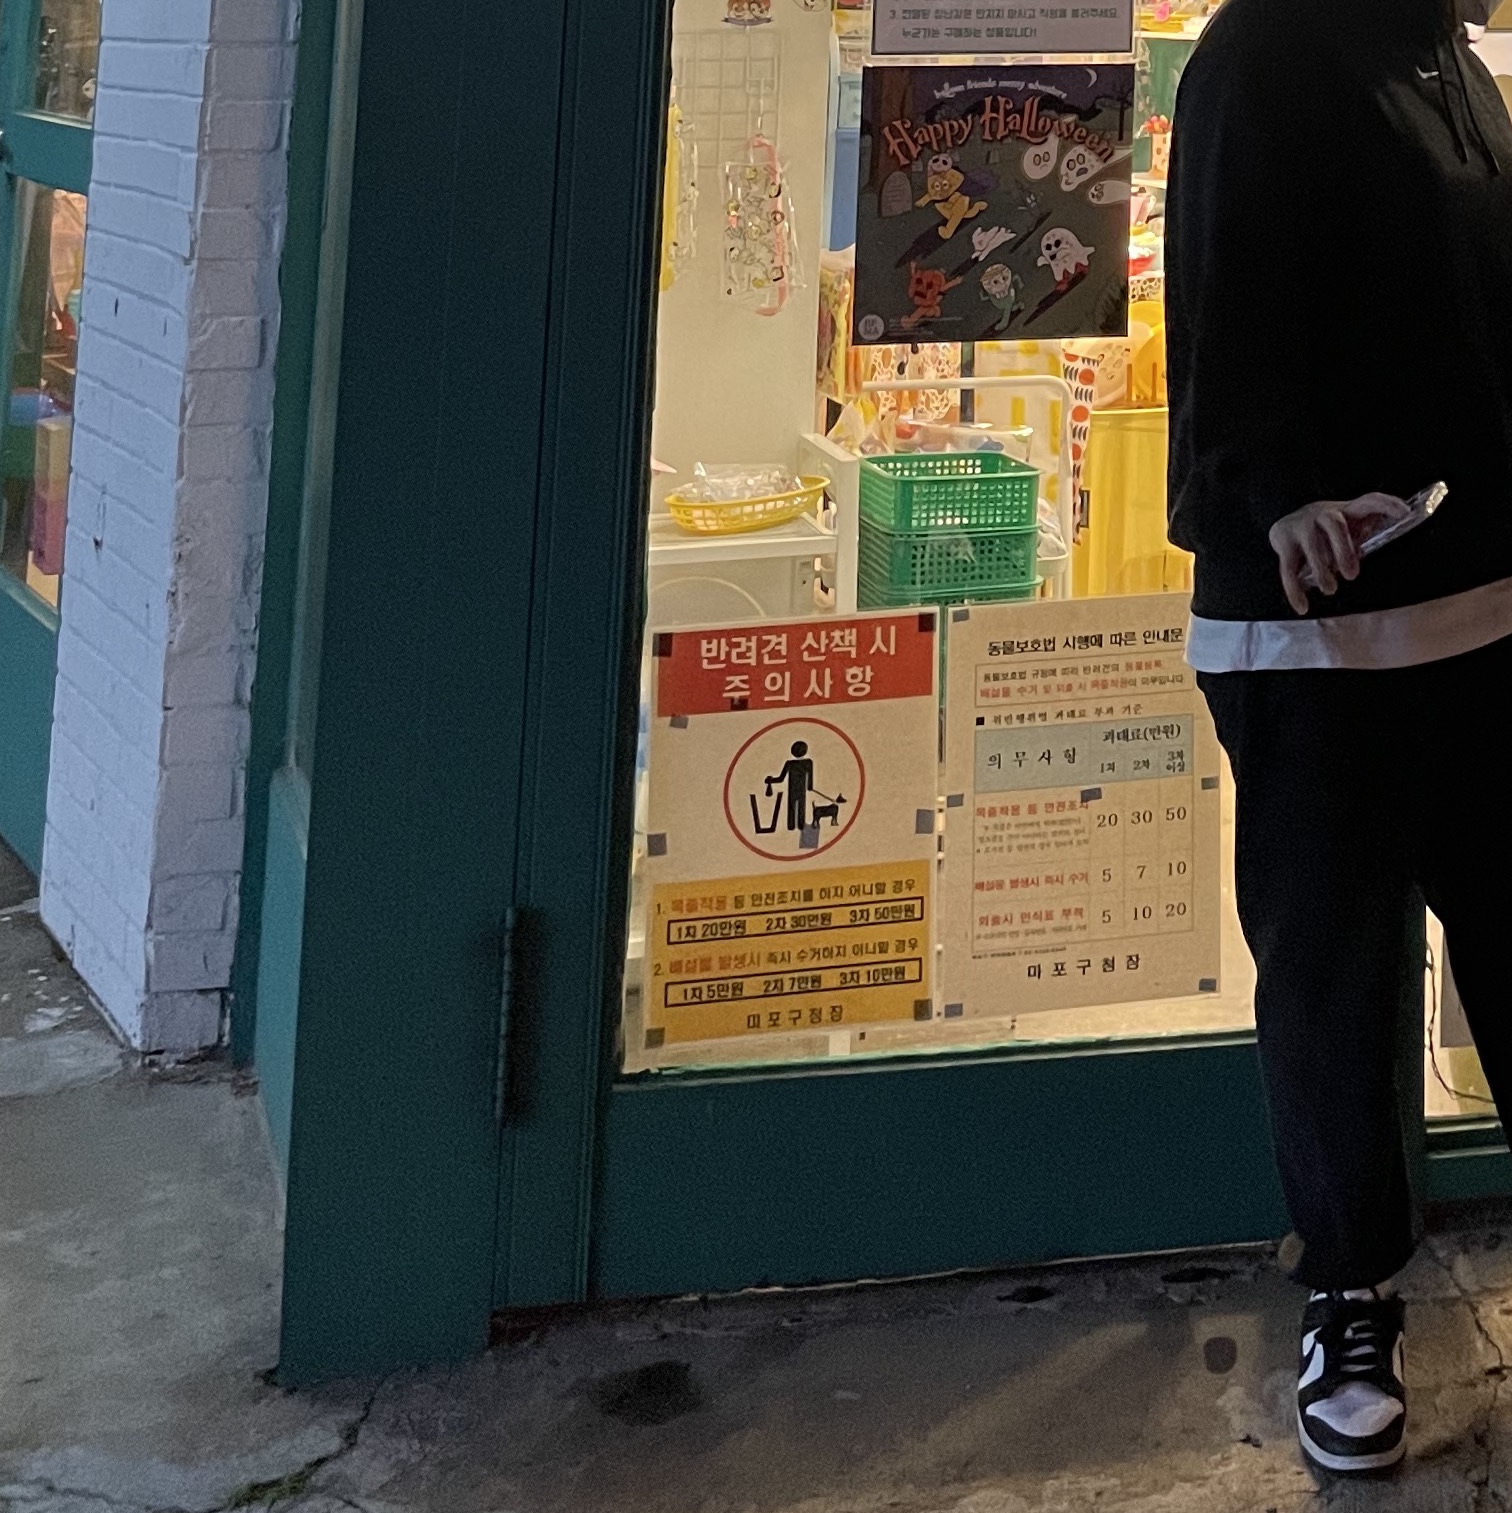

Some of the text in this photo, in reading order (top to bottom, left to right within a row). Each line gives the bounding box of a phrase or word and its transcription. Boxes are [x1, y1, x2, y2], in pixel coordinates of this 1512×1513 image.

[881, 95, 1118, 167] Happy Halloween
[700, 624, 897, 670] 반려견 산책 시
[987, 627, 1184, 657] 동물보호법 시행에 따른 안내문
[1096, 813, 1119, 828] 20
[1130, 809, 1153, 825] 30
[1165, 806, 1188, 821] 50
[1101, 868, 1112, 883] 5
[1136, 864, 1146, 879] 7
[1167, 860, 1187, 876] 10
[655, 903, 666, 915] 1.
[892, 878, 916, 894] 경우
[1101, 909, 1112, 924] 5
[1133, 905, 1152, 920] 10
[1165, 902, 1187, 917] 20
[677, 923, 697, 940] 1차
[701, 919, 748, 937] 20만원
[765, 916, 788, 931] 2차
[790, 912, 833, 929] 30만원
[874, 903, 916, 920] 50만원
[653, 963, 665, 977] 2.
[895, 938, 919, 954] 경우
[683, 985, 703, 1001] 1차
[706, 982, 744, 1000] 5만원
[763, 978, 784, 994] 2차
[789, 974, 822, 990] 7만원
[865, 965, 906, 983] 10만원
